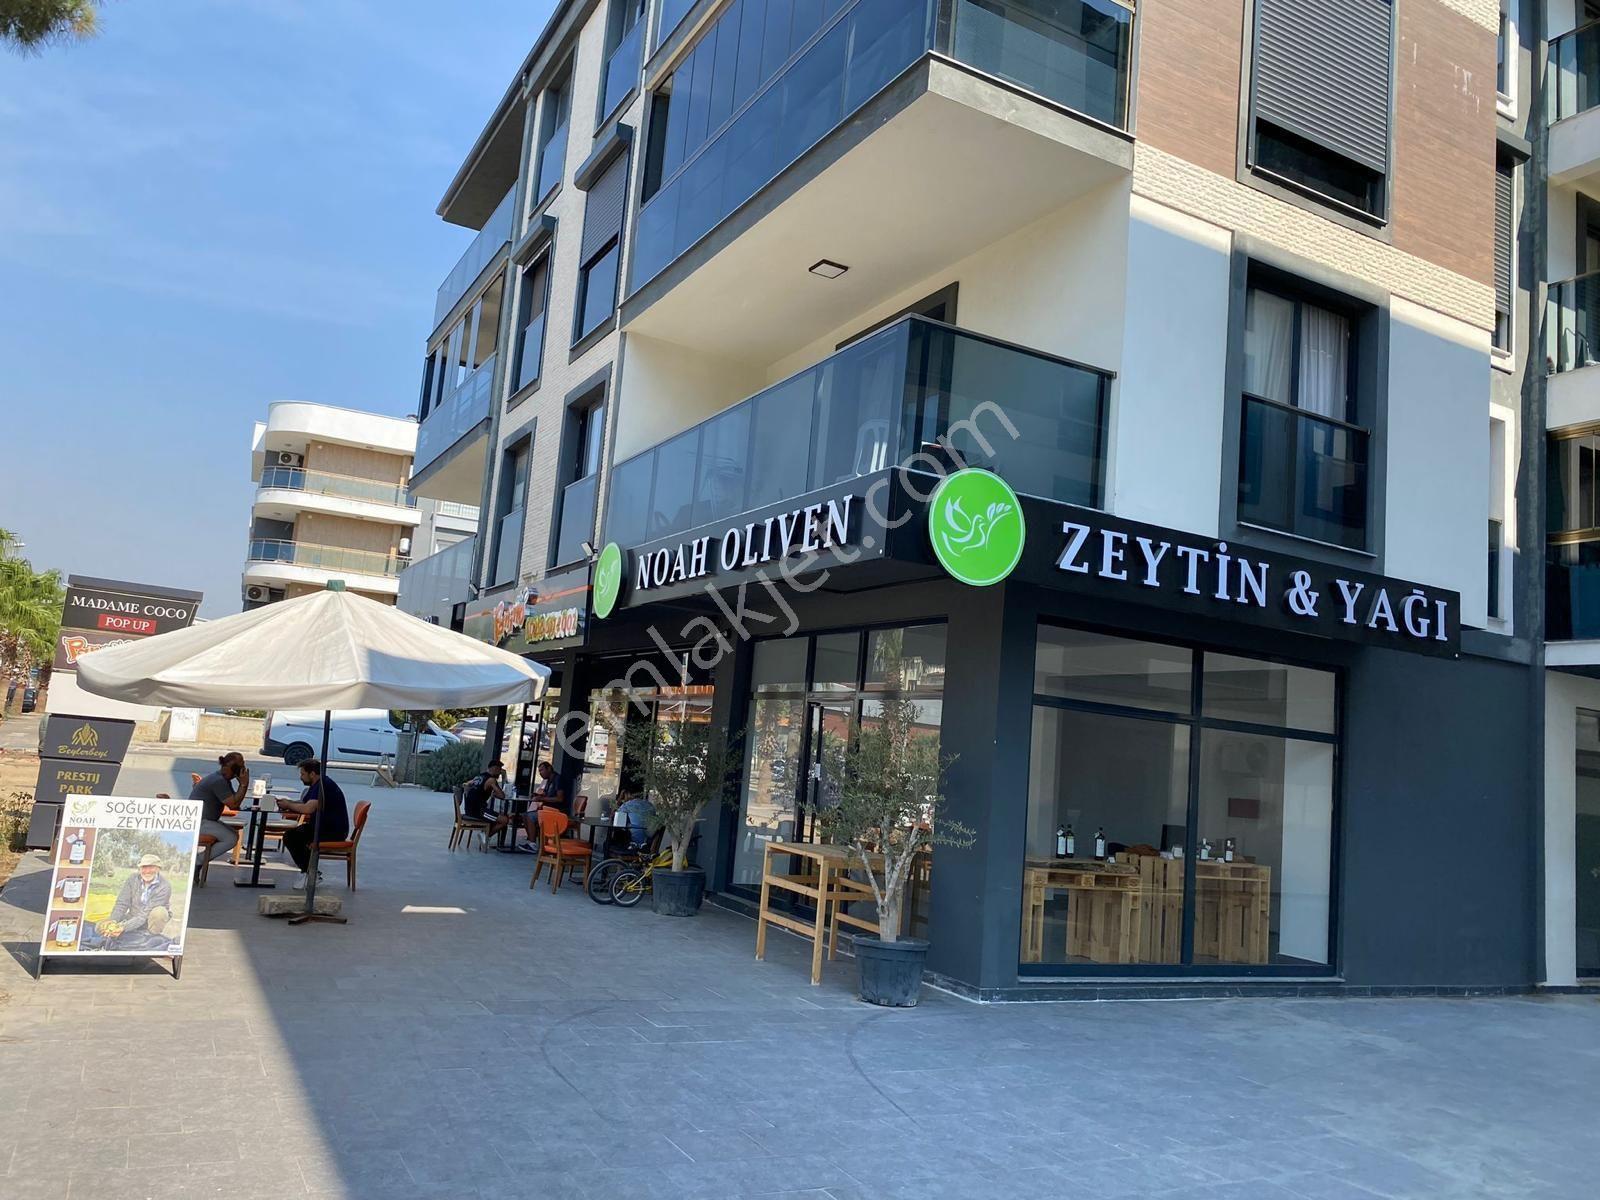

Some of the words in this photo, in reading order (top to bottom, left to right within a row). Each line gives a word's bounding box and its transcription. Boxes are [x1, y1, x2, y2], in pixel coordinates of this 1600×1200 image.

[635, 535, 710, 591] NOAH
[720, 494, 855, 572] OLIVEN
[1059, 521, 1269, 608] ZEYTİN
[1287, 570, 1319, 616] &
[1336, 578, 1448, 642] YAĞI
[71, 595, 140, 614] MADAME
[143, 604, 187, 620] COCO
[105, 616, 131, 629] POP
[133, 621, 150, 631] UP
[59, 784, 93, 794] PARK
[105, 800, 156, 815] SOĞUK
[160, 804, 199, 817] SIKIM
[69, 816, 96, 825] NOAH
[117, 815, 197, 831] ZEYTİNYAĞI
